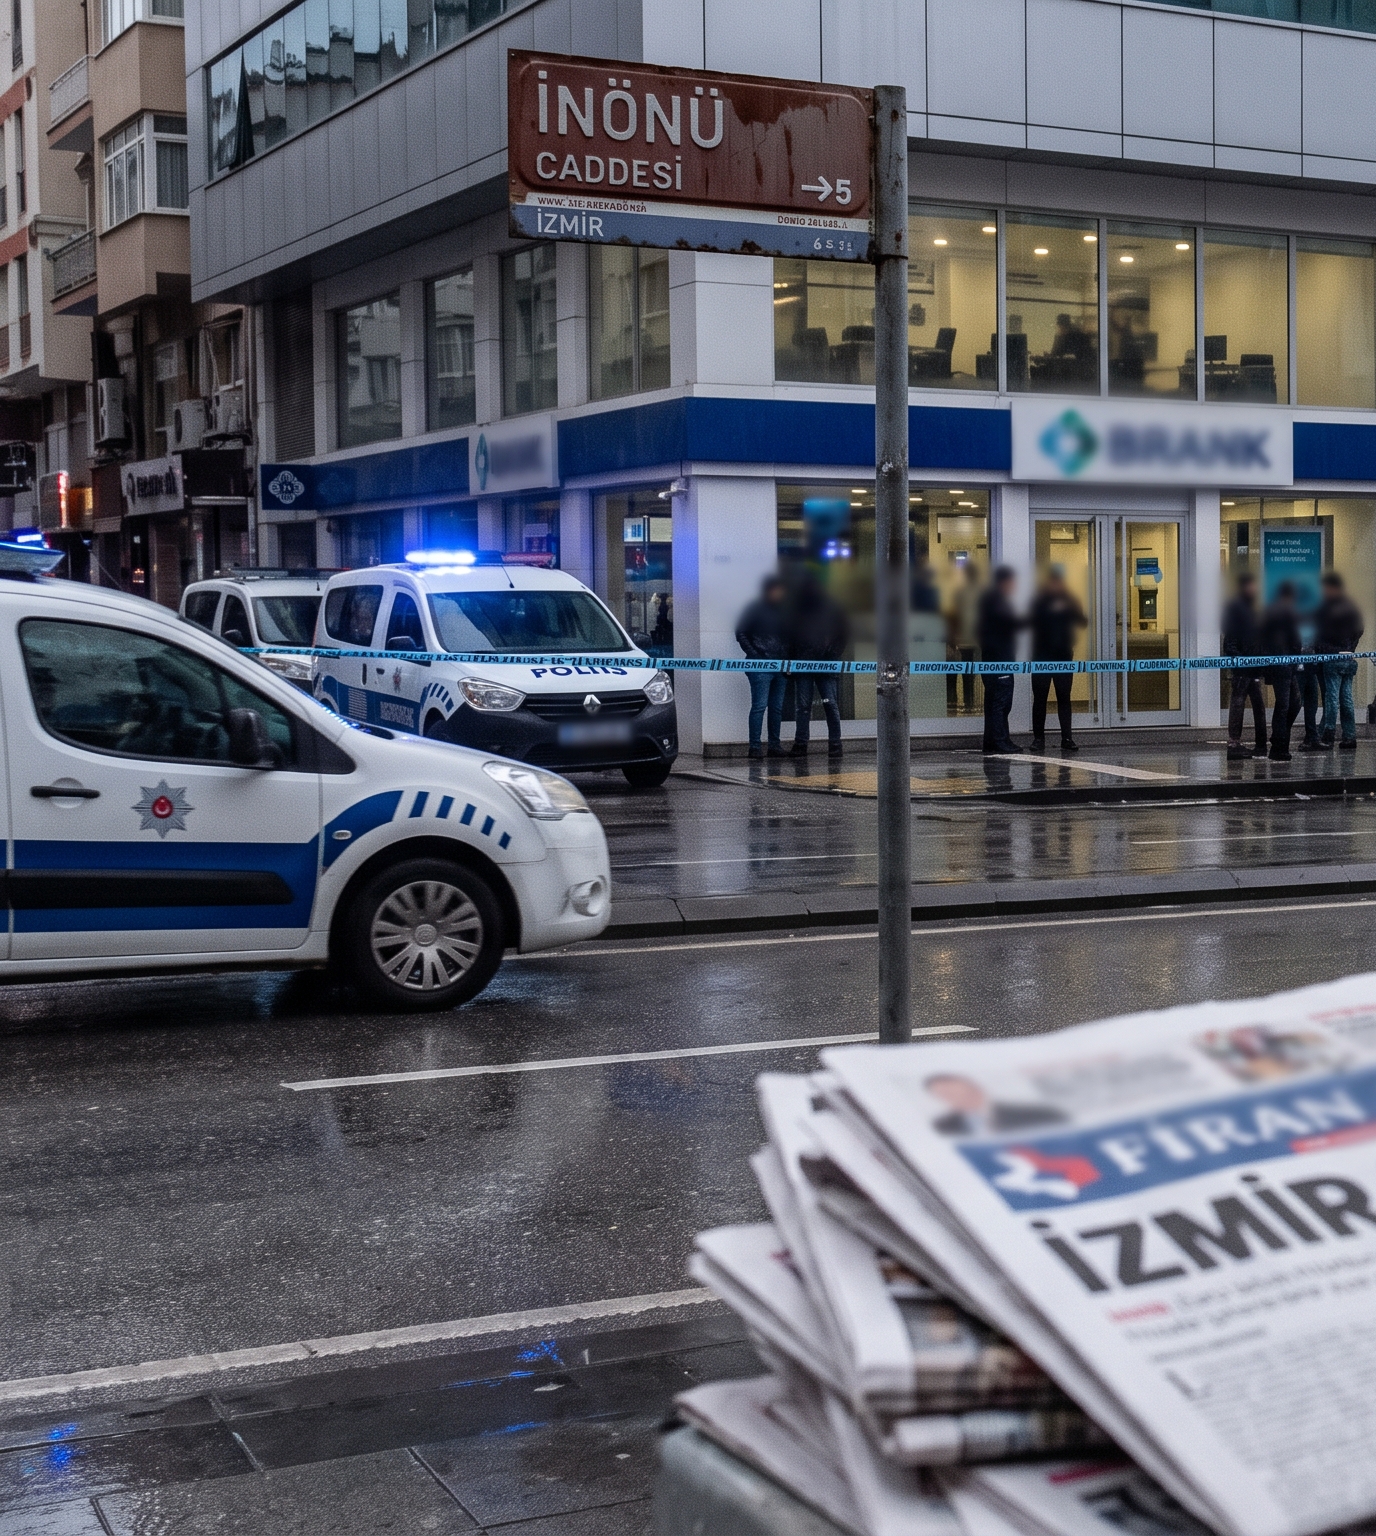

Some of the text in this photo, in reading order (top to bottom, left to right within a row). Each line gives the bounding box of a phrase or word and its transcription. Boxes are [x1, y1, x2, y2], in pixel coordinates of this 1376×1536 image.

[537, 70, 725, 149] İNÖNÜ
[536, 151, 683, 191] CADDESİ
[835, 178, 852, 205] 5
[537, 208, 604, 237] İZMİR
